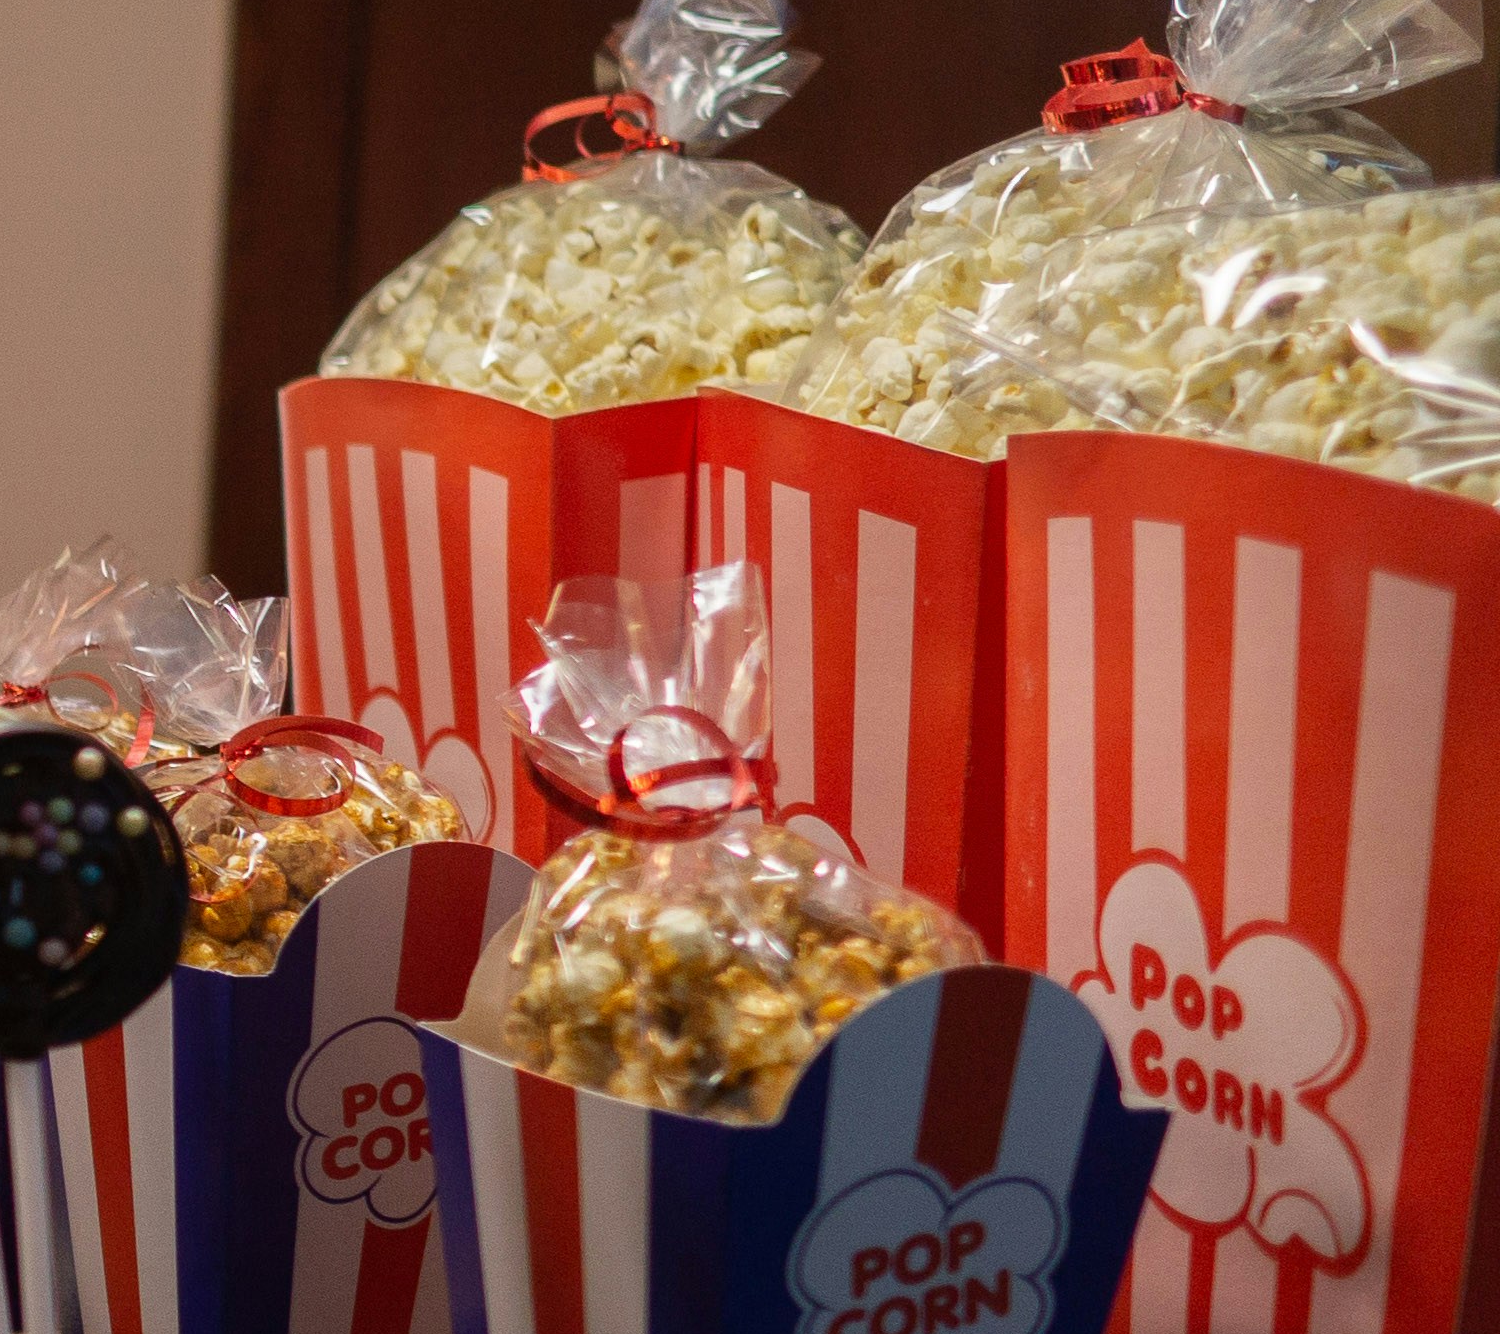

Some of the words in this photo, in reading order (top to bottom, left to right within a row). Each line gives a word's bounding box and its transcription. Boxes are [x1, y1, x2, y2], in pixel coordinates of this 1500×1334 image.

[1130, 942, 1244, 1041] POP
[342, 1072, 427, 1129] PO
[1130, 1028, 1285, 1147] CORN
[321, 1118, 435, 1180] COR
[852, 1220, 986, 1300] POP
